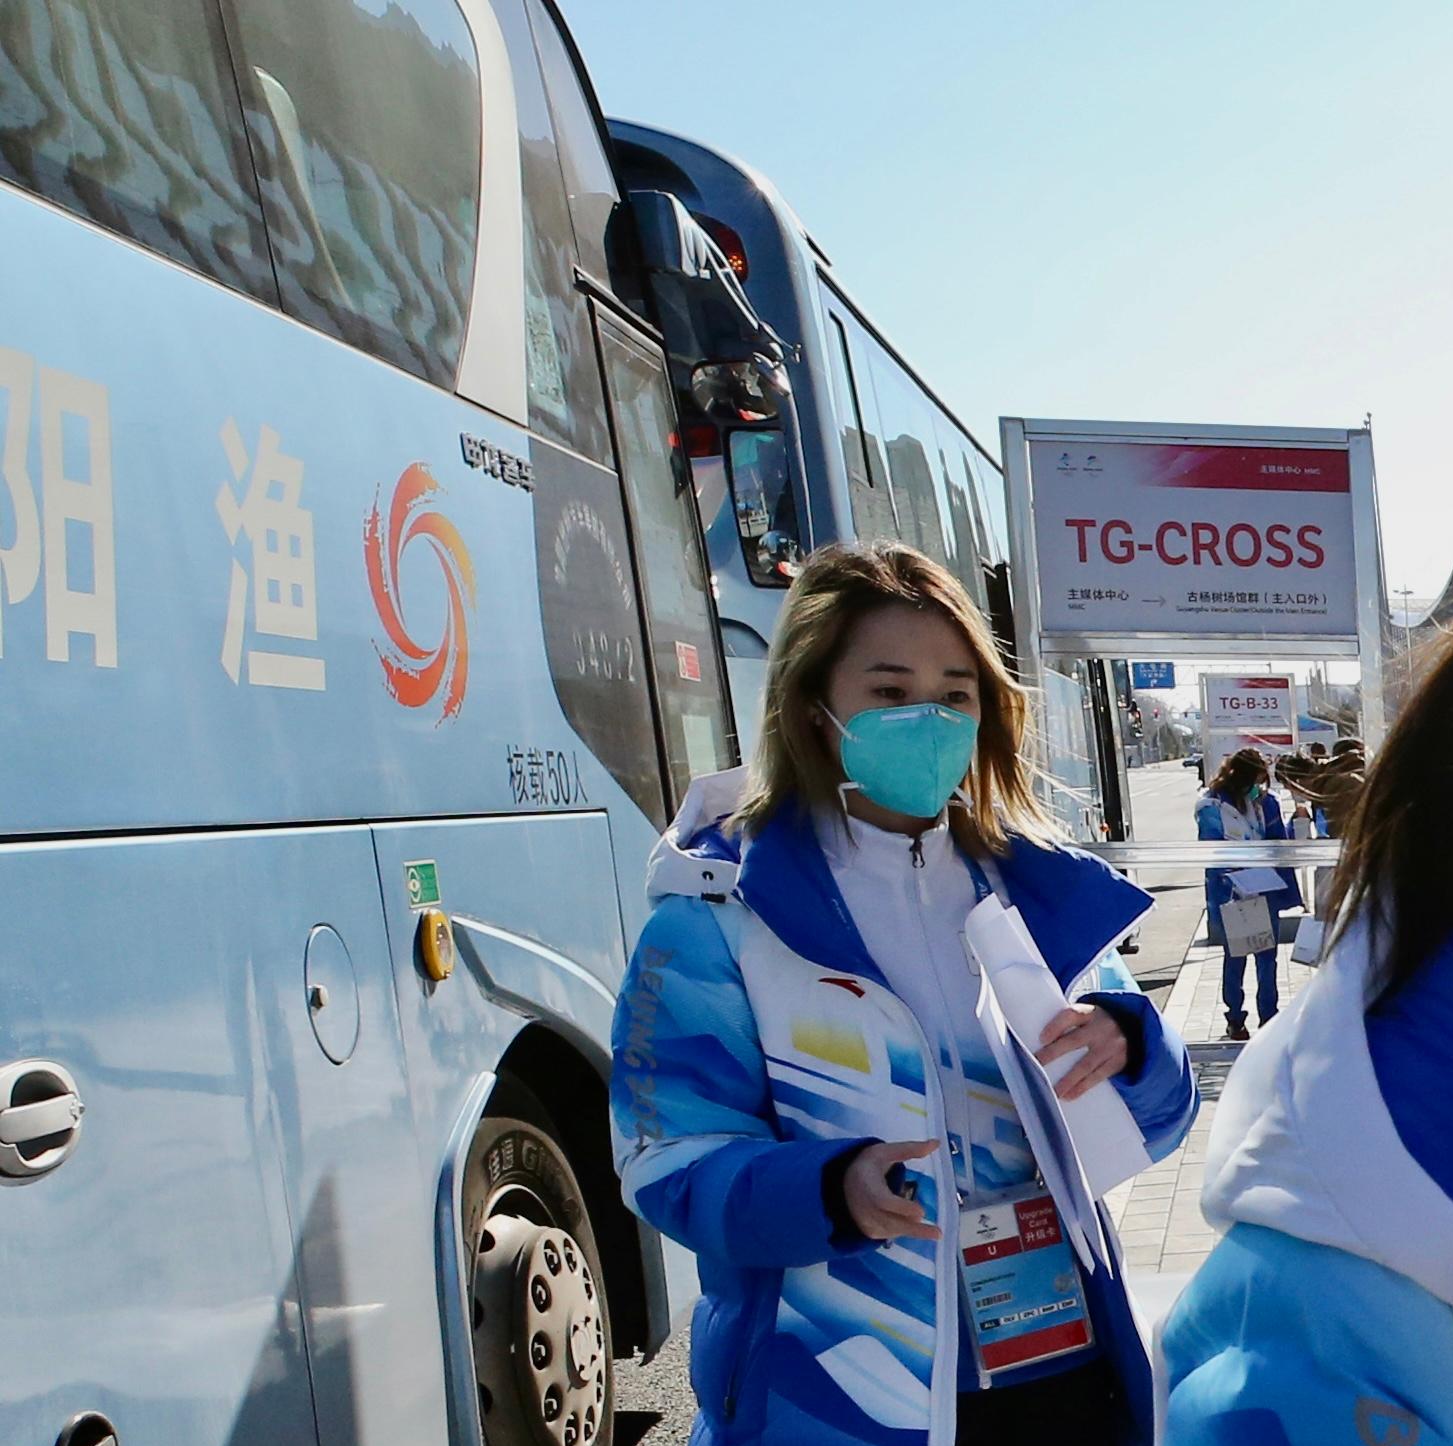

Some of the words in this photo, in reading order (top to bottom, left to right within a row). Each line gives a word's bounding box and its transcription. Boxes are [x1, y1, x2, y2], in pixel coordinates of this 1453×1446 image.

[214, 415, 326, 691] 渔
[1064, 518, 1325, 569] TG-CROSS
[1067, 588, 1129, 601] 主媒体中心
[1219, 697, 1278, 710] TG-B-33
[506, 744, 588, 806] 核载50人
[987, 1245, 997, 1255] U
